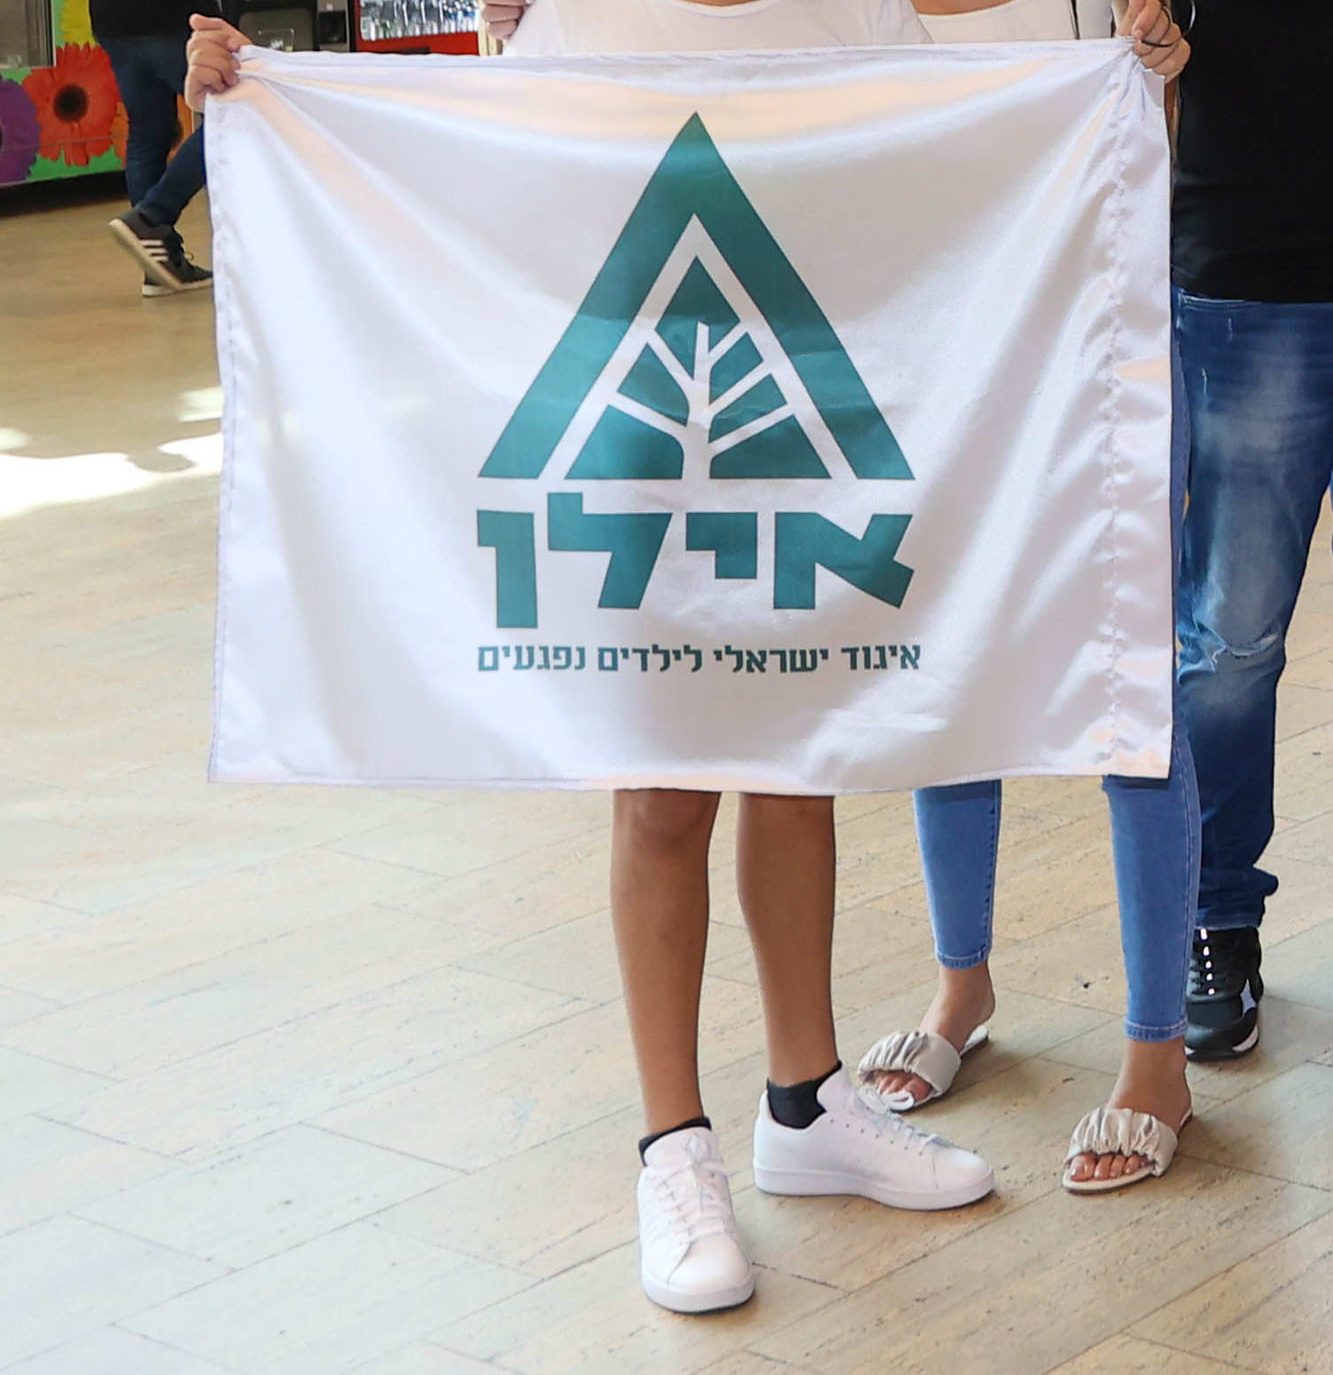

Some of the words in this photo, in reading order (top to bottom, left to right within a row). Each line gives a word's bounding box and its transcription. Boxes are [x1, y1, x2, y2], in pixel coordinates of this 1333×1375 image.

[477, 492, 915, 629] אילן
[477, 644, 586, 672] נפגעים
[598, 643, 702, 674] לילדים
[713, 646, 830, 674] ישראלי
[841, 644, 922, 671] איגוד
